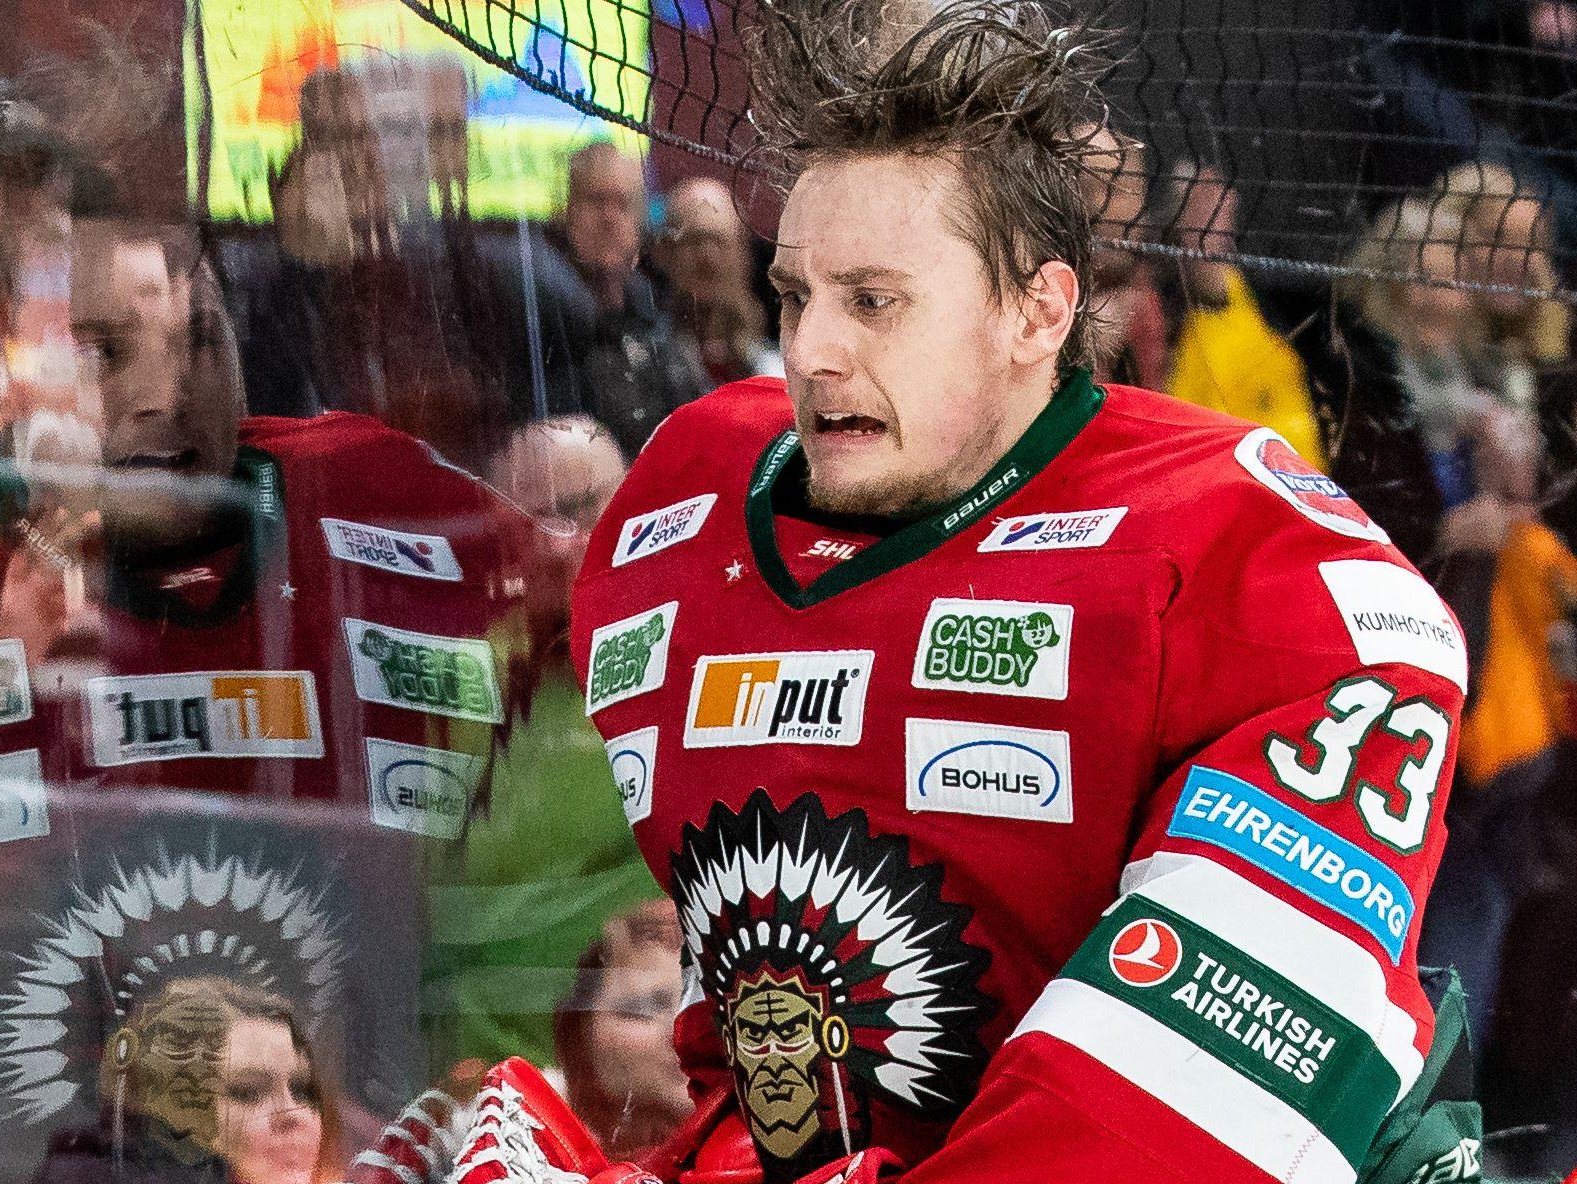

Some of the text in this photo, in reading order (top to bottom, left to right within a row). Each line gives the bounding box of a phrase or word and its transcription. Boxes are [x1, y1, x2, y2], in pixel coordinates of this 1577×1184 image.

[657, 502, 700, 530] INTER
[1045, 514, 1108, 532] INTER
[649, 520, 688, 548] SPORT
[1034, 528, 1094, 545] SPORT
[807, 539, 858, 560] SHL
[933, 616, 1016, 651] CASH
[1352, 611, 1421, 636] KUMHO
[927, 647, 1036, 687] BUDDY
[781, 725, 842, 739] interiör
[1262, 675, 1452, 855] 33
[941, 766, 1041, 796] BOHUS
[1184, 786, 1408, 939] EHRENBORG
[1192, 950, 1337, 1062] TURKISH
[1170, 987, 1321, 1086] AIRLINES
